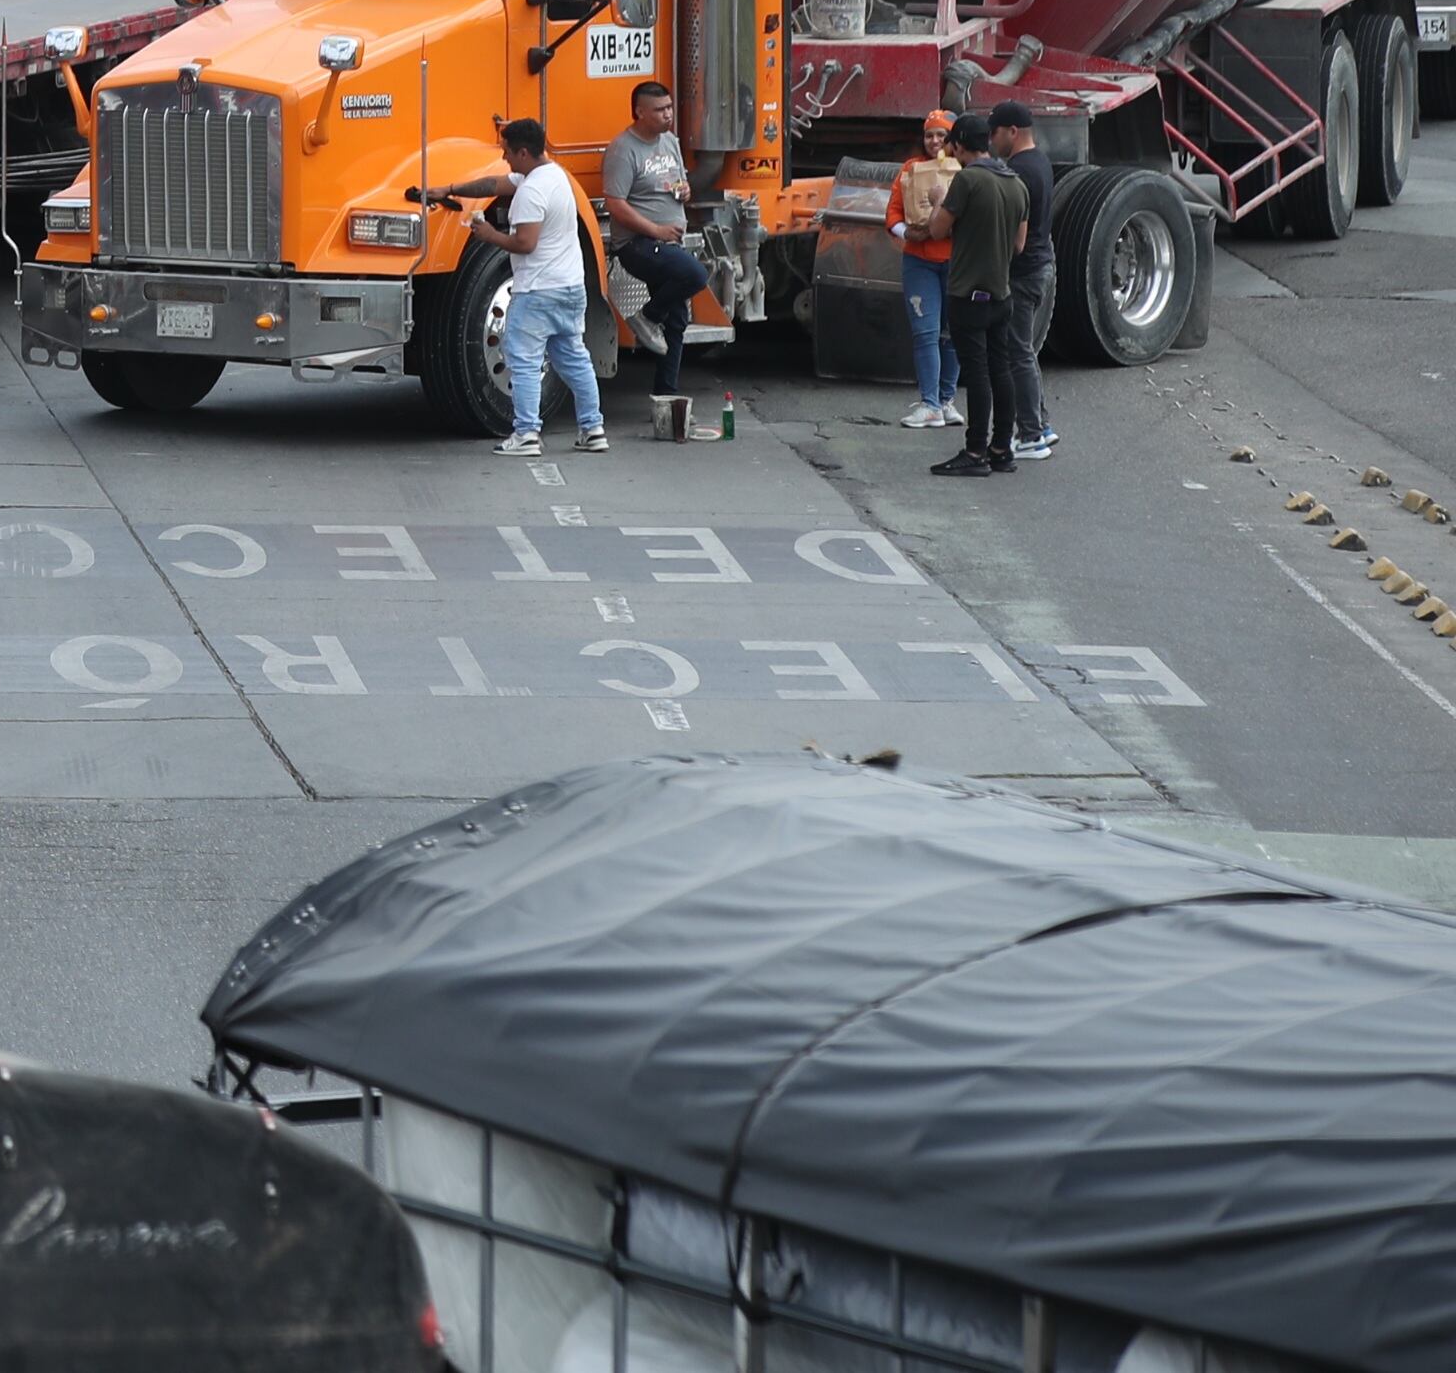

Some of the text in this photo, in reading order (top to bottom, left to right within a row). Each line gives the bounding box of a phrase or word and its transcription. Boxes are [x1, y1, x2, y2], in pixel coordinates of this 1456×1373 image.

[602, 63, 641, 74] DUITAMA
[342, 94, 392, 108] KENWORTH
[740, 158, 779, 173] CAT
